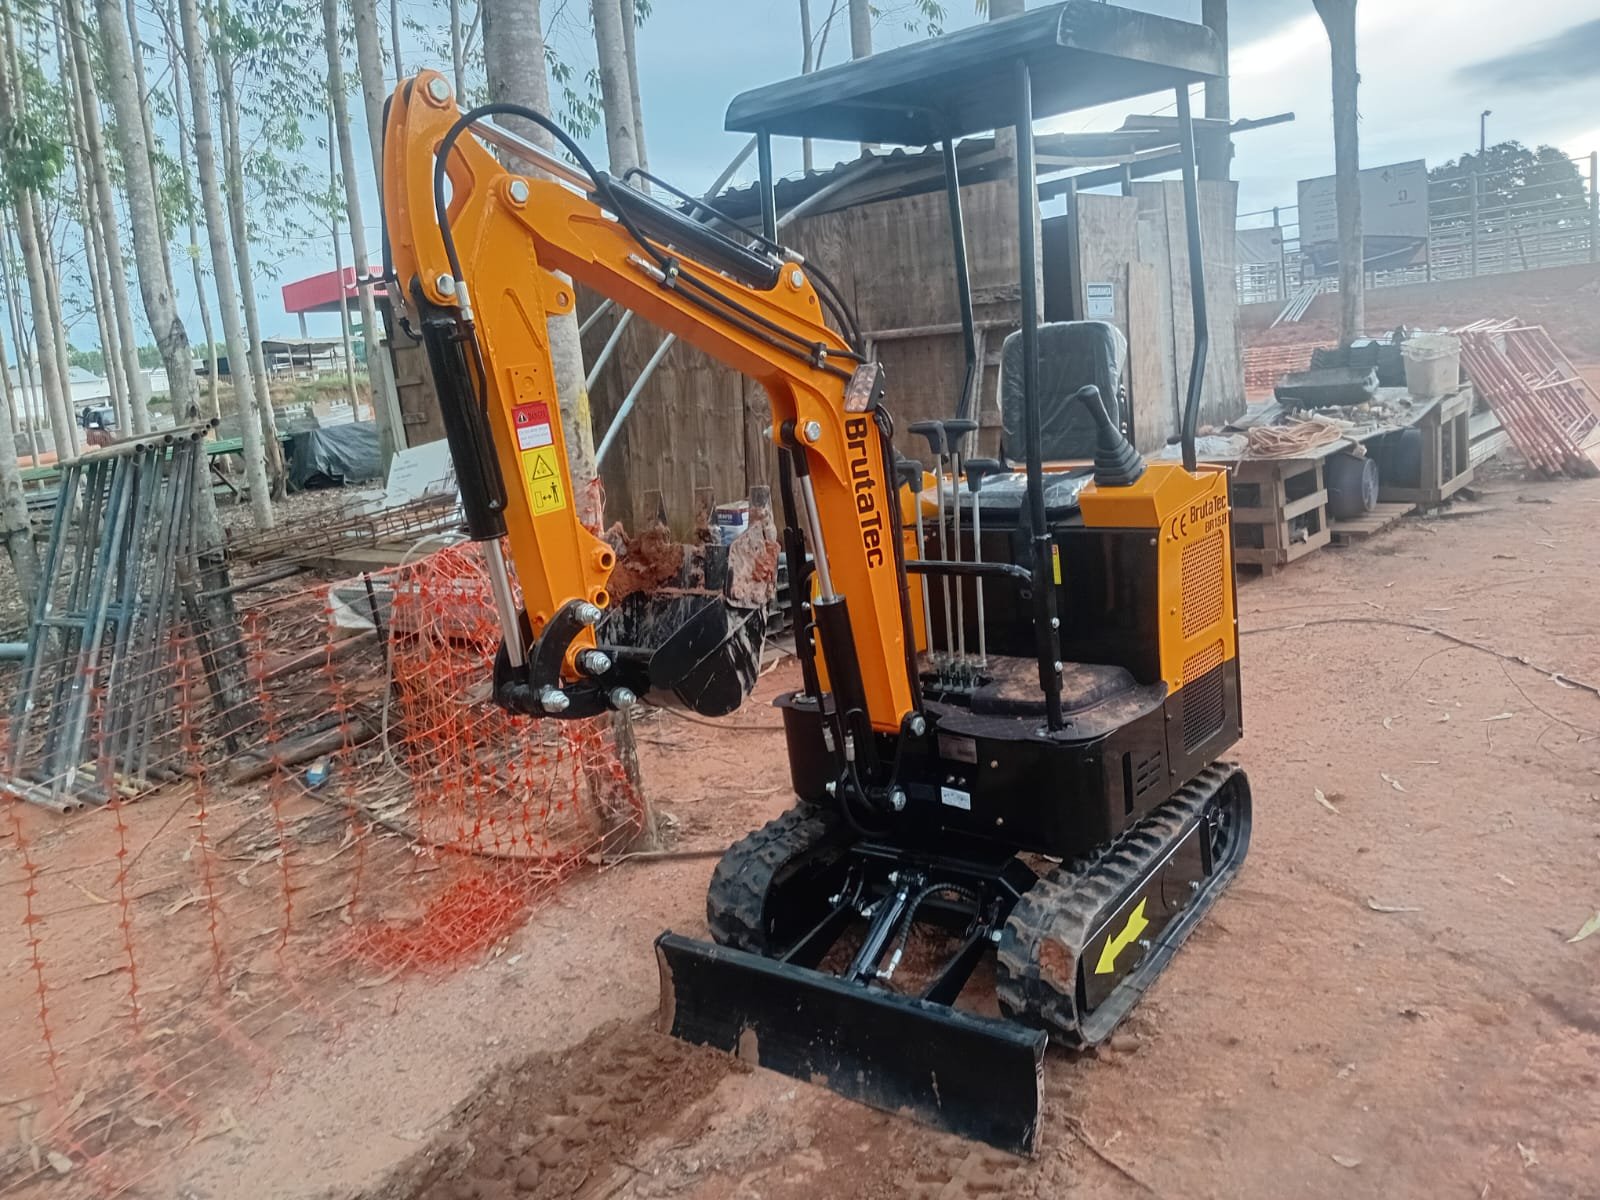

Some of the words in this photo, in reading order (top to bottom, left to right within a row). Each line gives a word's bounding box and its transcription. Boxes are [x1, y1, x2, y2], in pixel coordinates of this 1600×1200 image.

[844, 417, 884, 569] BrutaTec
[1190, 495, 1226, 524] BrutaTec
[1171, 513, 1187, 540] CE
